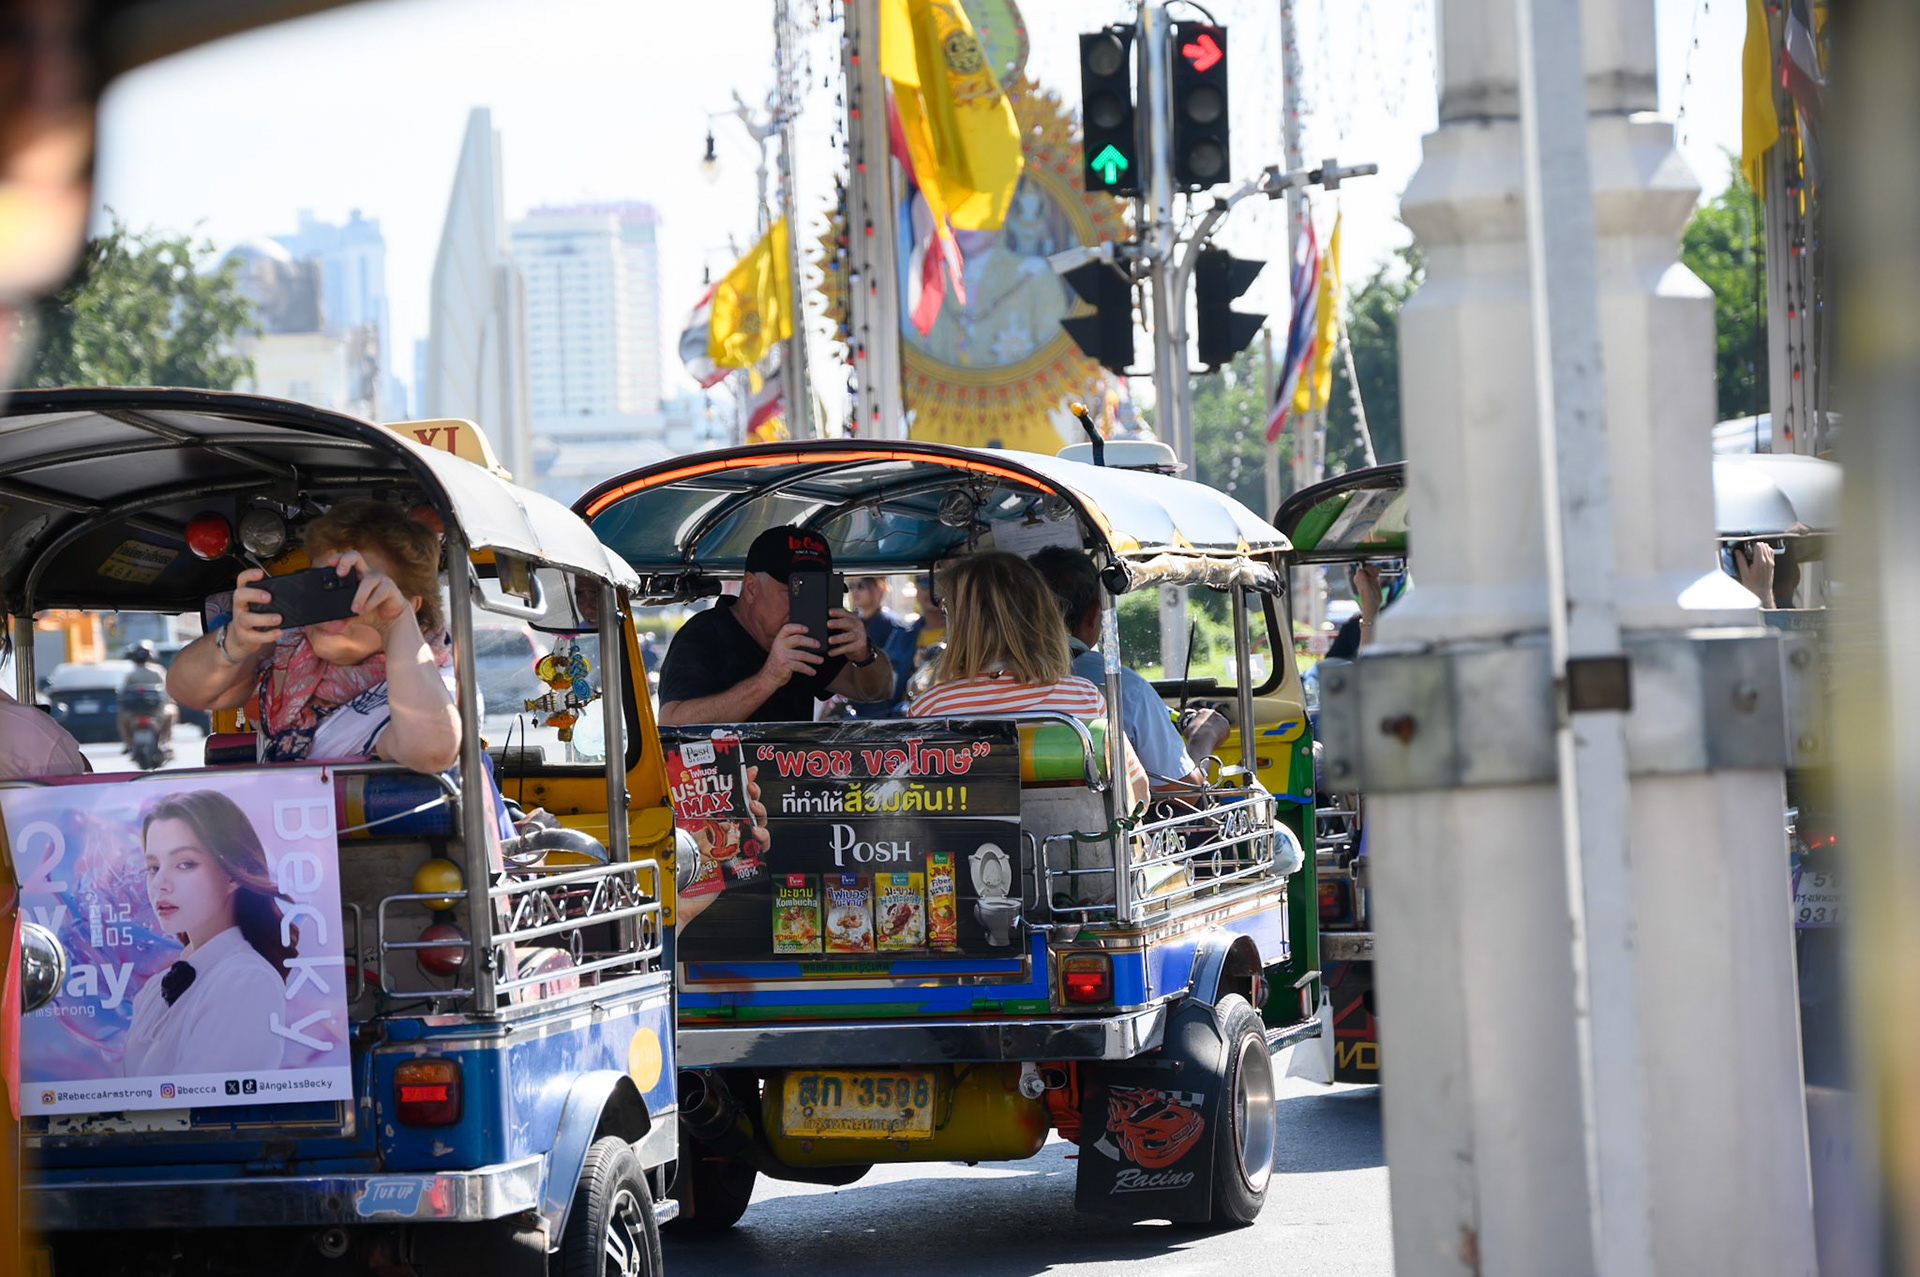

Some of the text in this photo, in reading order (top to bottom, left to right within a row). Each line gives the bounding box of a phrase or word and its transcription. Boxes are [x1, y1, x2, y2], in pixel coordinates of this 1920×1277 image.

[671, 774, 733, 803] มะขาม
[680, 790, 734, 819] MAX
[16, 820, 68, 893] 2
[736, 867, 758, 880] 100%
[932, 878, 952, 887] Fiber
[775, 897, 818, 909] Kombucha
[780, 888, 813, 899] มะขาม
[104, 903, 131, 924] 12
[269, 799, 346, 1052] Becky
[106, 926, 133, 947] 05
[57, 957, 135, 1010] ay
[23, 1004, 96, 1019] mstrong
[57, 1088, 153, 1101] @RebeccaArmstrong
[177, 1085, 217, 1095] @beccca
[259, 1079, 333, 1091] @AngelssBecky
[858, 1077, 929, 1109] 3598
[1109, 1167, 1195, 1195] Racing
